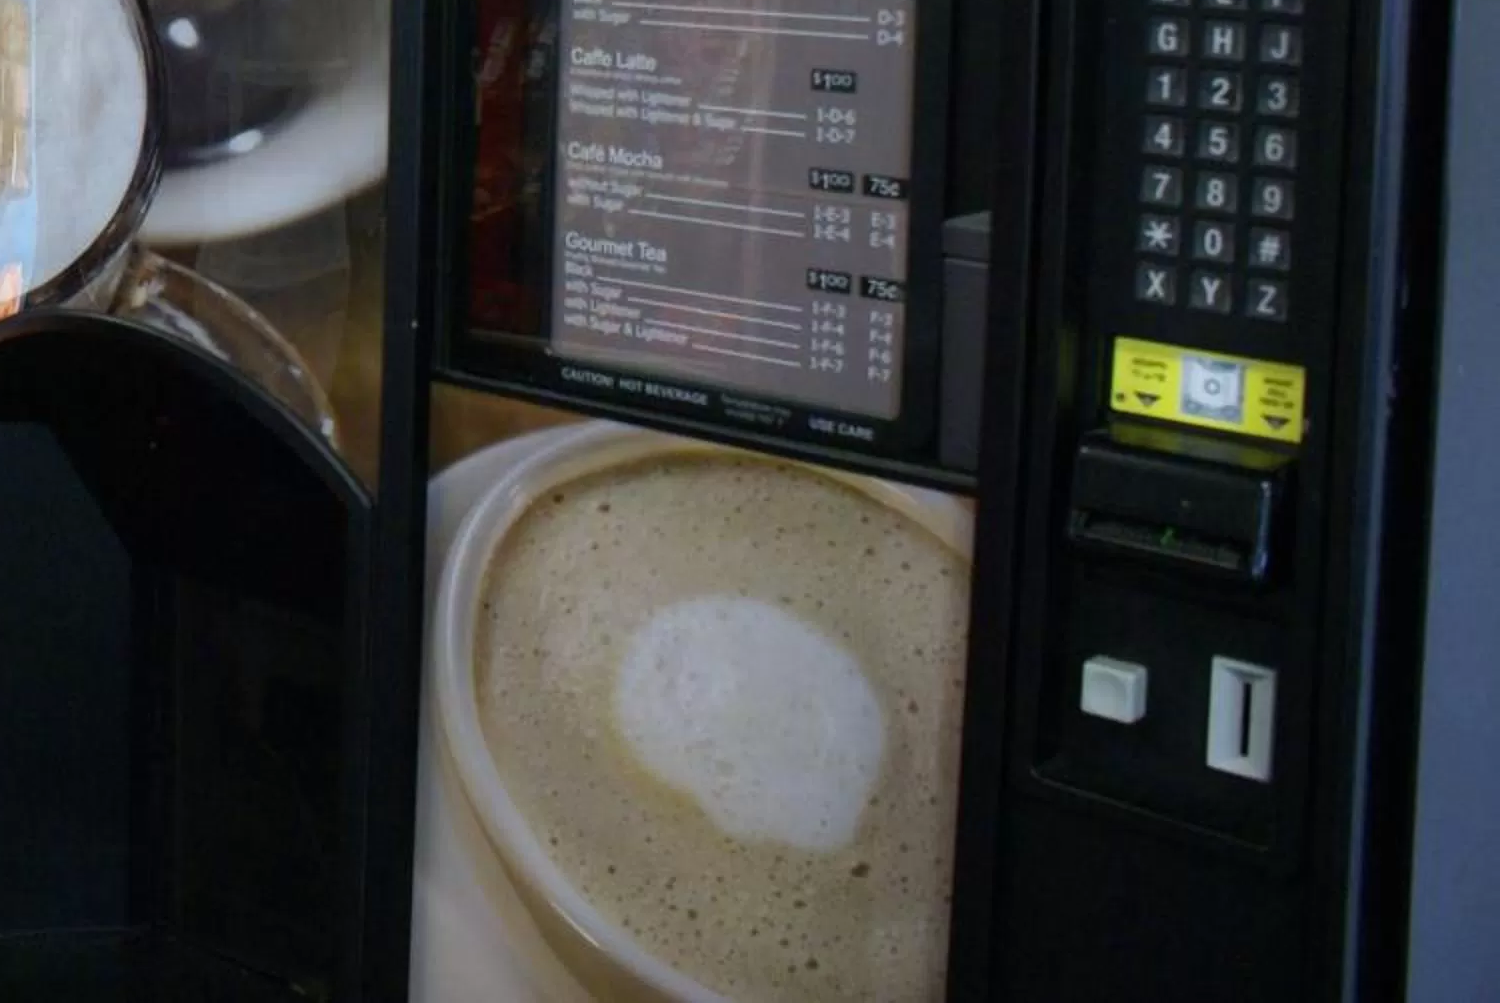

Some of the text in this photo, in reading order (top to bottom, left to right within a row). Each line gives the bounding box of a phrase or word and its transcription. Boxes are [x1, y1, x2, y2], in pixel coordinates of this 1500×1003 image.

[1158, 23, 1289, 59] G H J
[1157, 74, 1287, 110] 1 2 3
[607, 143, 664, 170] Mocha
[1155, 123, 1284, 162] 4 5 6
[1155, 173, 1282, 213] 7 8 9
[564, 230, 633, 258] Gourmet
[636, 240, 668, 263] Tea
[1204, 228, 1223, 257] 0
[867, 278, 898, 299] 75¢
[1147, 270, 1277, 315] X Y Z
